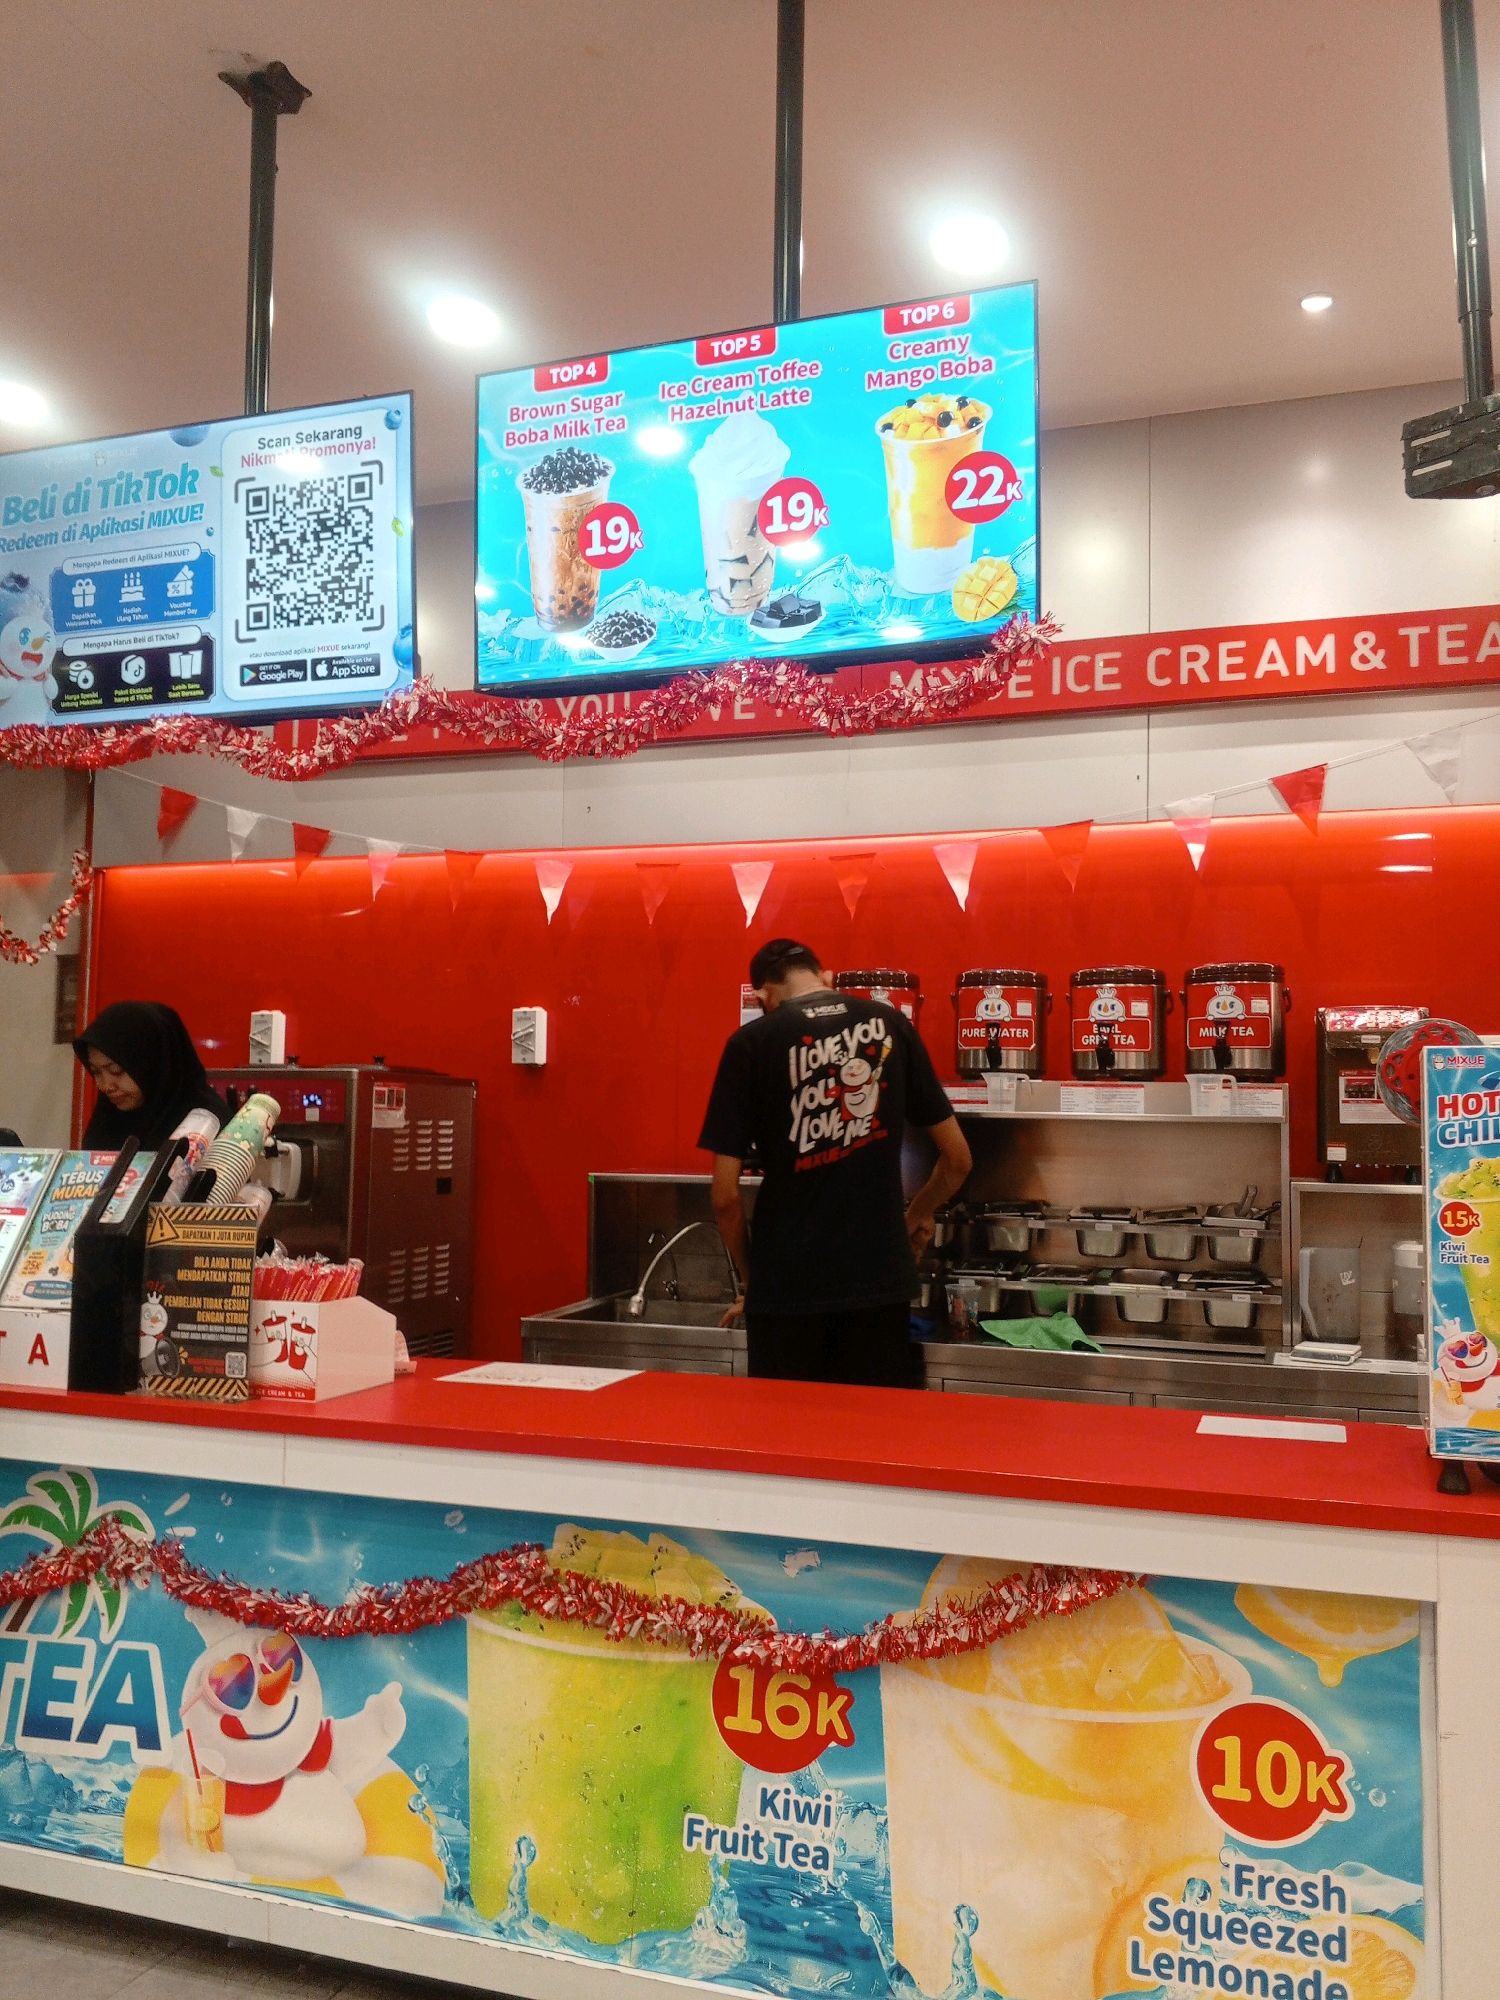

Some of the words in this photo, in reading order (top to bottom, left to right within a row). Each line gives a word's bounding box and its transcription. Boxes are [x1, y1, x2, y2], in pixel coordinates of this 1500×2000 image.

[900, 304, 940, 326] TOP
[942, 301, 955, 319] 6
[710, 337, 748, 358] TOP
[749, 334, 761, 351] 5
[888, 335, 970, 360] Creamy
[549, 364, 584, 385] TOP
[585, 361, 597, 378] 4
[660, 383, 687, 399] Ice
[691, 373, 752, 394] Cream
[757, 360, 820, 384] Toffee
[866, 366, 936, 390] Mango
[940, 356, 993, 379] Boba
[509, 402, 566, 423] Brown
[570, 392, 623, 413] Sugar
[670, 395, 754, 422] Hazelnut
[759, 388, 810, 410] Latte
[257, 436, 291, 450] Scan
[295, 425, 362, 445] Sekarang
[505, 427, 549, 447] Boba
[553, 419, 590, 440] Milk
[594, 417, 626, 433] Tea
[3, 483, 58, 527] Beli
[62, 476, 92, 517] di
[97, 462, 200, 510] TikTok
[951, 464, 1022, 510] 22K
[765, 491, 829, 535] 19K
[0, 531, 58, 553] Redeem
[61, 522, 77, 543] di
[79, 511, 144, 543] Aplikasi
[148, 503, 204, 530] MIXUE!
[584, 515, 644, 557] 19K
[72, 559, 101, 571] Mengapa
[102, 556, 129, 567] Redeem
[129, 554, 136, 562] di
[137, 551, 163, 562] Aplikasi
[164, 549, 190, 558] MIXUE?
[83, 639, 112, 649] Mengapa
[113, 637, 132, 647] Harus
[133, 636, 146, 644] Beli
[147, 635, 154, 643] di
[155, 632, 180, 643] TikTok?
[263, 649, 292, 658] download
[293, 647, 316, 656] aplikasi
[317, 644, 340, 653] MIXUE
[341, 641, 371, 652] sekarang!
[1052, 651, 1122, 696] ICE
[1147, 633, 1336, 687] CREAM
[1350, 630, 1387, 671] &
[1398, 619, 1500, 668] TEA
[258, 671, 287, 682] Google
[287, 668, 304, 680] Play
[331, 666, 350, 677] App
[351, 663, 375, 675] Store
[962, 1028, 986, 1038] PURE
[1113, 1035, 1136, 1046] TEA
[1199, 1027, 1227, 1038] MILK
[1231, 1026, 1255, 1037] TEA
[1447, 1055, 1485, 1065] MIXUE
[1438, 1091, 1500, 1119] HOT
[61, 1170, 105, 1185] TEBUS
[42, 1210, 76, 1223] PUDDING
[1442, 1210, 1481, 1228] 15K
[182, 1230, 212, 1241] DAPATKAN
[217, 1231, 231, 1241] JUTA
[232, 1231, 255, 1242] RUPIAH
[1440, 1241, 1466, 1252] Kiwi
[194, 1256, 210, 1269] BILA
[210, 1256, 230, 1269] ANDA
[231, 1257, 252, 1270] TIDAK
[1440, 1253, 1469, 1265] Fruit
[1470, 1254, 1490, 1265] Tea
[177, 1268, 228, 1283] MENDAPATKAN
[228, 1270, 251, 1284] STRUK
[231, 1284, 250, 1298] ATAU
[202, 1297, 223, 1310] TIDAK
[197, 1310, 224, 1324] DENGAN
[225, 1312, 249, 1325] STRUK
[723, 1663, 849, 1741] 16K
[1211, 1735, 1339, 1809] 10K
[760, 1786, 833, 1828] Kiwi
[685, 1816, 765, 1861] Fruit
[772, 1831, 831, 1872] Tea
[1234, 1863, 1347, 1915] Fresh
[1148, 1897, 1348, 1963] Squeezed
[1130, 1940, 1349, 2000] Lemonade
